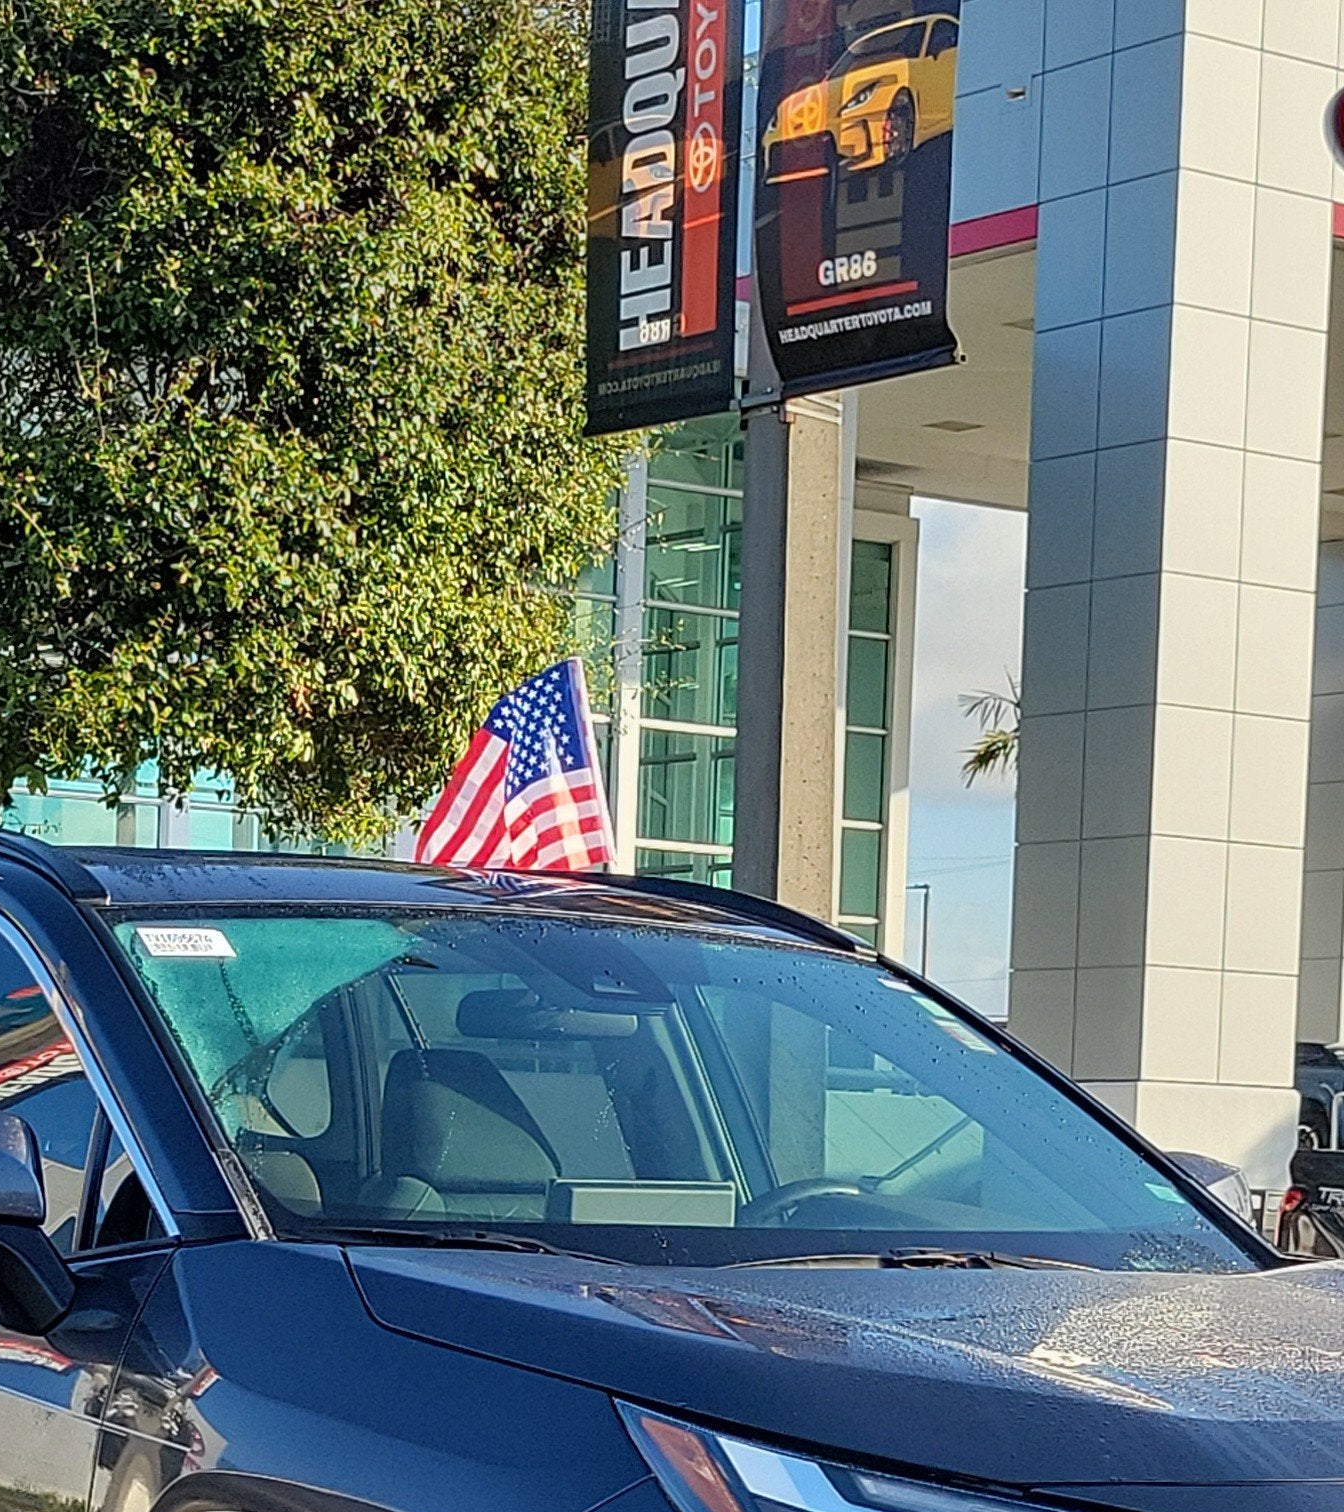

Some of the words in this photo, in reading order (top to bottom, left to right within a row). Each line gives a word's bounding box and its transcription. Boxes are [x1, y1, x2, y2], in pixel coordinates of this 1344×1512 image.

[619, 0, 686, 351] HEADQU
[818, 250, 877, 286] GR86
[778, 300, 933, 345] HEADQUARTERTOYOTA.COM
